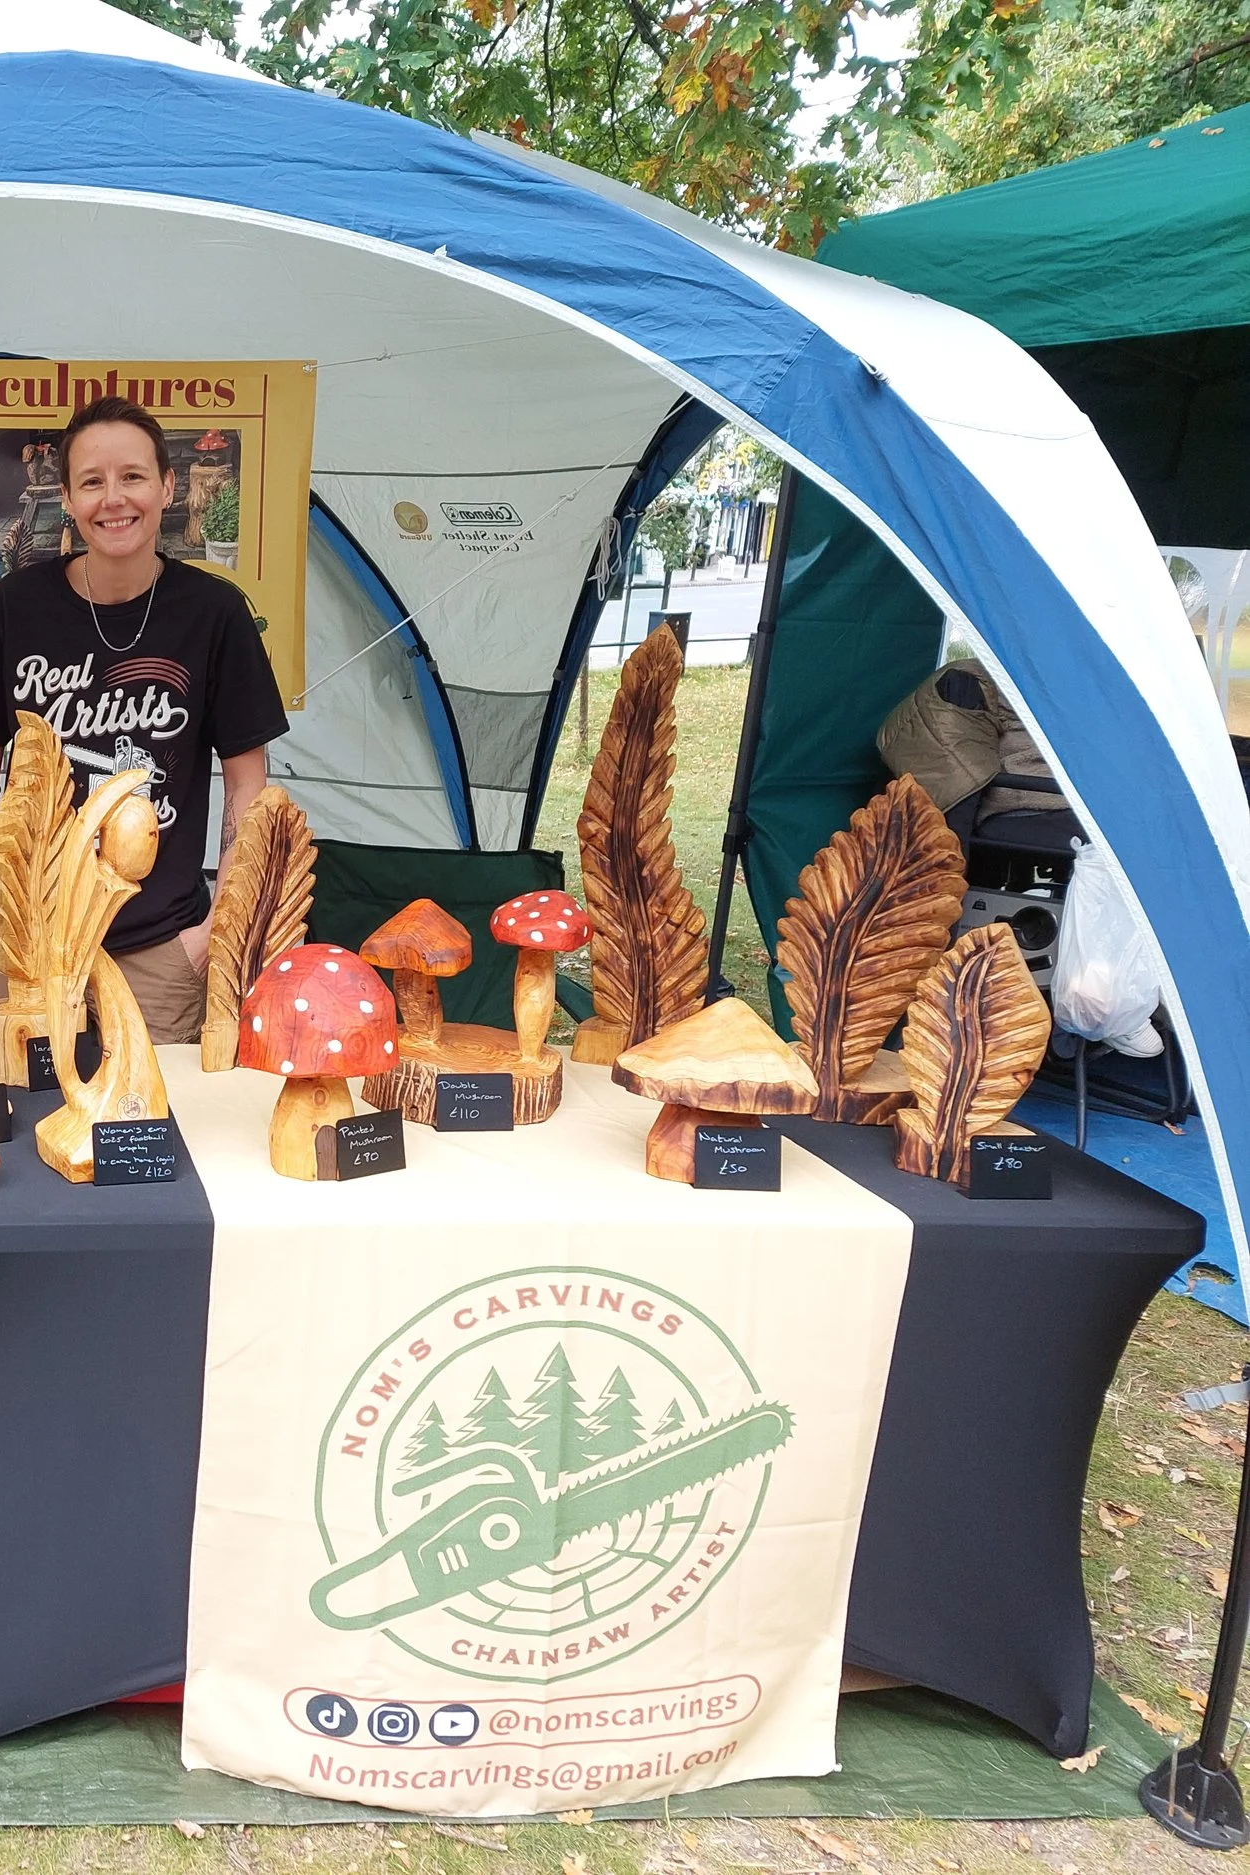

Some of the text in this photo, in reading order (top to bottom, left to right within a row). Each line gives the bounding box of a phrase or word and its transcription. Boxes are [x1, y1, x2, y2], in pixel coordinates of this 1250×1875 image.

[13, 652, 95, 706] Real
[43, 685, 189, 740] Artists
[437, 1080, 479, 1090] Double
[455, 1093, 502, 1101] Mushroom
[449, 1106, 480, 1119] £110
[98, 1126, 142, 1136] Women's
[338, 1123, 375, 1139] Painted
[698, 1131, 743, 1143] Natural
[99, 1134, 165, 1144] 2025 football
[349, 1135, 394, 1150] Mushroom
[975, 1141, 1003, 1151] Small
[714, 1145, 766, 1154] Mushroom
[718, 1159, 748, 1175] £50
[992, 1156, 1023, 1171] £80
[145, 1166, 172, 1178] £120
[340, 1284, 684, 1459] NOM'S CARVINGS
[450, 1521, 738, 1667] CHAINSAW ARTIST
[488, 1687, 739, 1737] @nomscarvings
[308, 1738, 740, 1791] Nomscarvings@gmail.com
